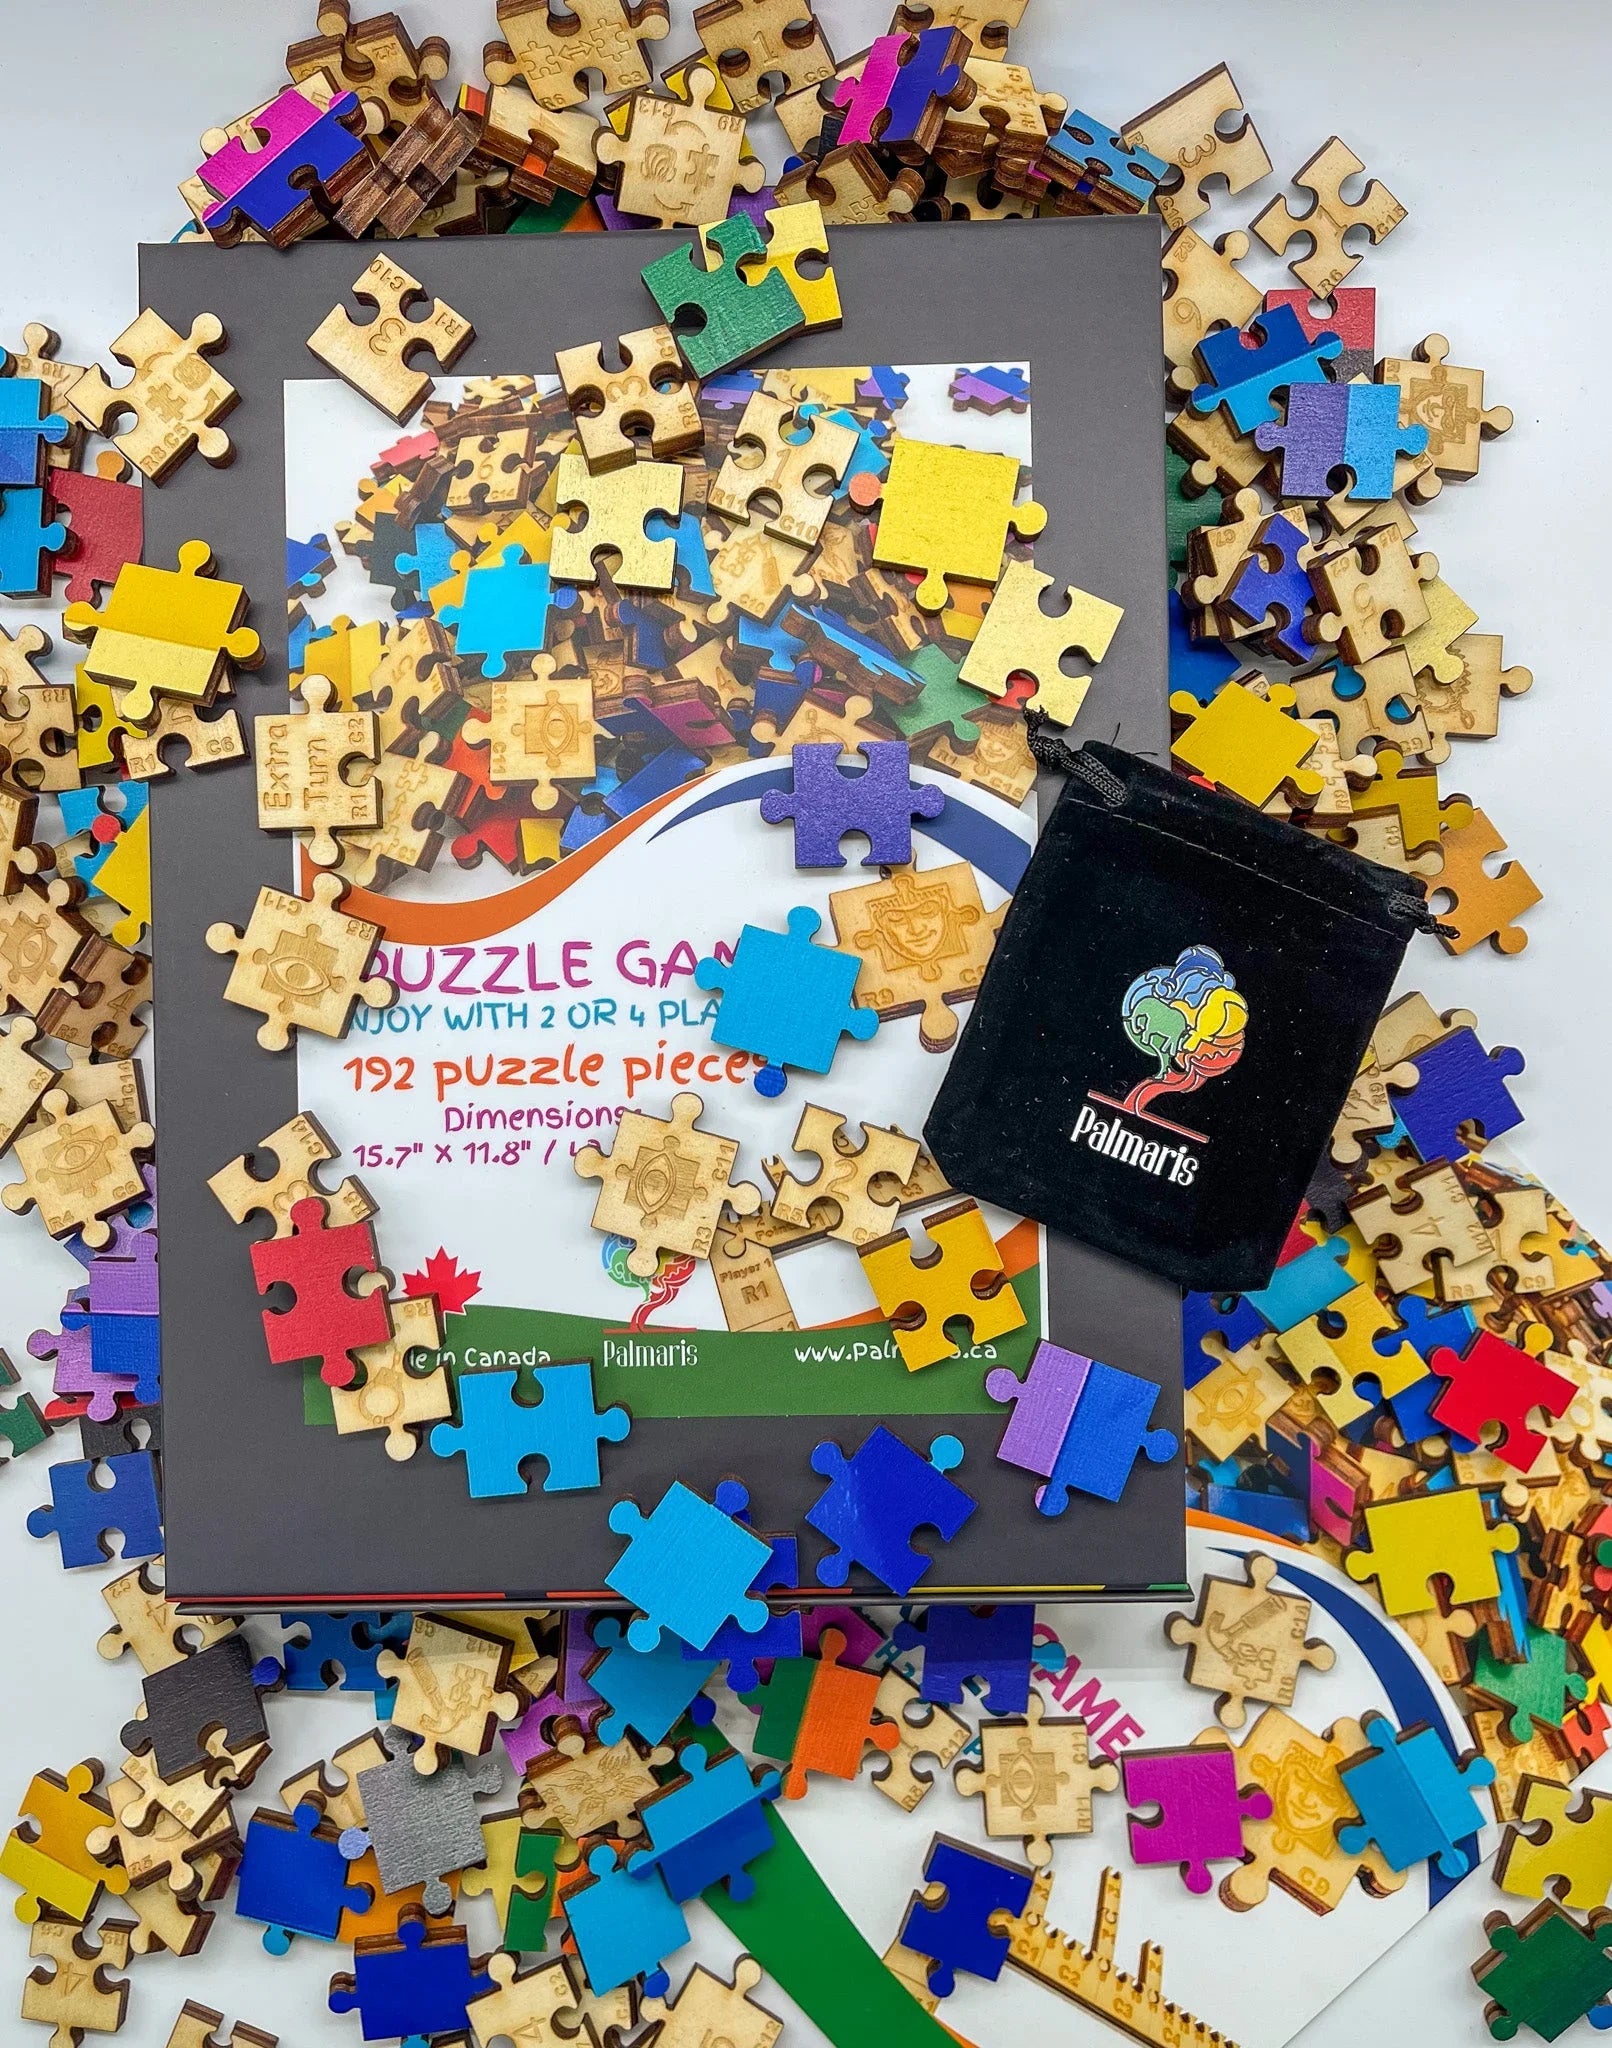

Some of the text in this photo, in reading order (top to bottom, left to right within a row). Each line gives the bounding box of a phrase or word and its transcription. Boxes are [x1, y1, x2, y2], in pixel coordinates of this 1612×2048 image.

[754, 31, 780, 65] 1
[618, 71, 643, 85] C3
[803, 67, 830, 81] C6
[540, 93, 565, 108] R6
[639, 98, 676, 117] C13
[718, 117, 742, 132] R9
[1179, 134, 1217, 169] 3
[1162, 198, 1181, 229] C16
[1317, 204, 1348, 238] 1
[1377, 206, 1404, 235] C15
[1173, 236, 1196, 263] R2
[370, 261, 402, 289] C10
[1317, 268, 1344, 292] R6
[369, 317, 406, 353] 3
[436, 313, 461, 336] R1
[606, 377, 646, 405] 3
[141, 427, 189, 475] R8 C5
[766, 449, 790, 488] 1
[715, 488, 745, 512] R11
[781, 517, 817, 543] C10
[348, 718, 364, 743] C2
[206, 737, 234, 753] C6
[129, 754, 156, 772] R1
[264, 724, 290, 810] Extra
[303, 737, 328, 809] Turn
[351, 795, 369, 819] R1
[262, 891, 302, 914] C11
[347, 921, 373, 940] R5
[108, 990, 136, 1019] 4
[863, 990, 894, 1006] R9
[349, 998, 721, 1034] NJOY WITH 2 OR 4 PLA
[29, 1068, 48, 1089] C5
[344, 1057, 414, 1092] 192
[433, 1043, 604, 1103] puzzle
[291, 1121, 322, 1156] C14
[1070, 1105, 1199, 1186] Palmaris
[353, 1142, 423, 1168] 15.7"
[464, 1141, 530, 1166] 11.8"
[545, 1139, 557, 1164] /
[711, 1143, 735, 1181] C11
[113, 1181, 137, 1200] C6
[825, 1159, 858, 1201] 2
[1442, 1173, 1464, 1202] C11
[51, 1212, 74, 1229] R4
[778, 1202, 804, 1223] R5
[691, 1226, 712, 1253] R3
[720, 1264, 761, 1283] Player
[741, 1281, 769, 1305] R1
[465, 1347, 550, 1366] Canada
[604, 1340, 698, 1367] Palmaris
[794, 1340, 998, 1362] www.Pal.ca
[109, 1580, 131, 1597] C2
[146, 1603, 172, 1630] 4
[63, 1963, 88, 1996] 4
[550, 1973, 565, 1996] C2
[756, 2022, 780, 2044] 12
